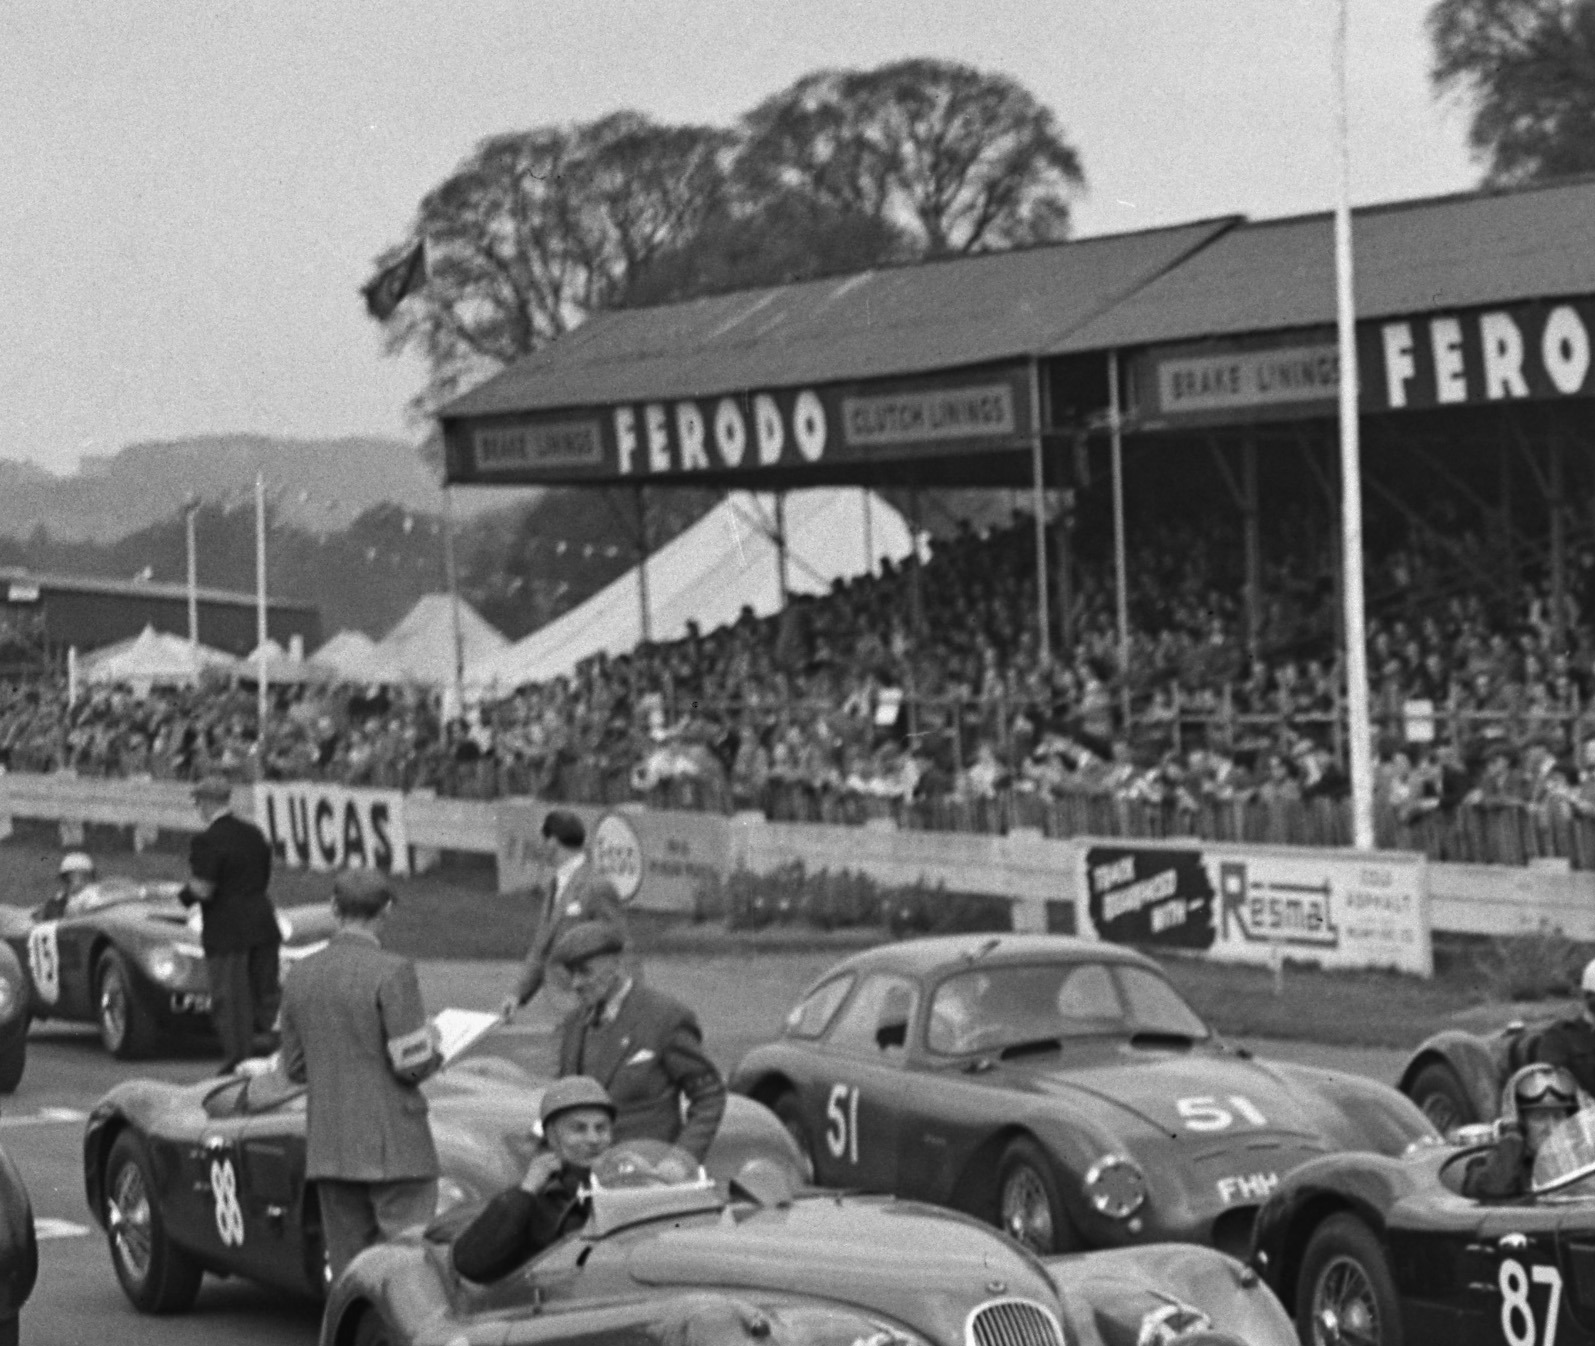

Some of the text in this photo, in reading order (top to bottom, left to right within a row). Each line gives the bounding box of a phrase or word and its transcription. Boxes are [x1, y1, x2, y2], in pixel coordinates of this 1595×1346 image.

[1172, 364, 1240, 401] BRAKE
[613, 390, 827, 475] FERODO
[264, 795, 397, 870] LUCAS
[826, 1083, 860, 1164] 51
[1175, 1095, 1268, 1131] 51
[210, 1157, 245, 1247] 88
